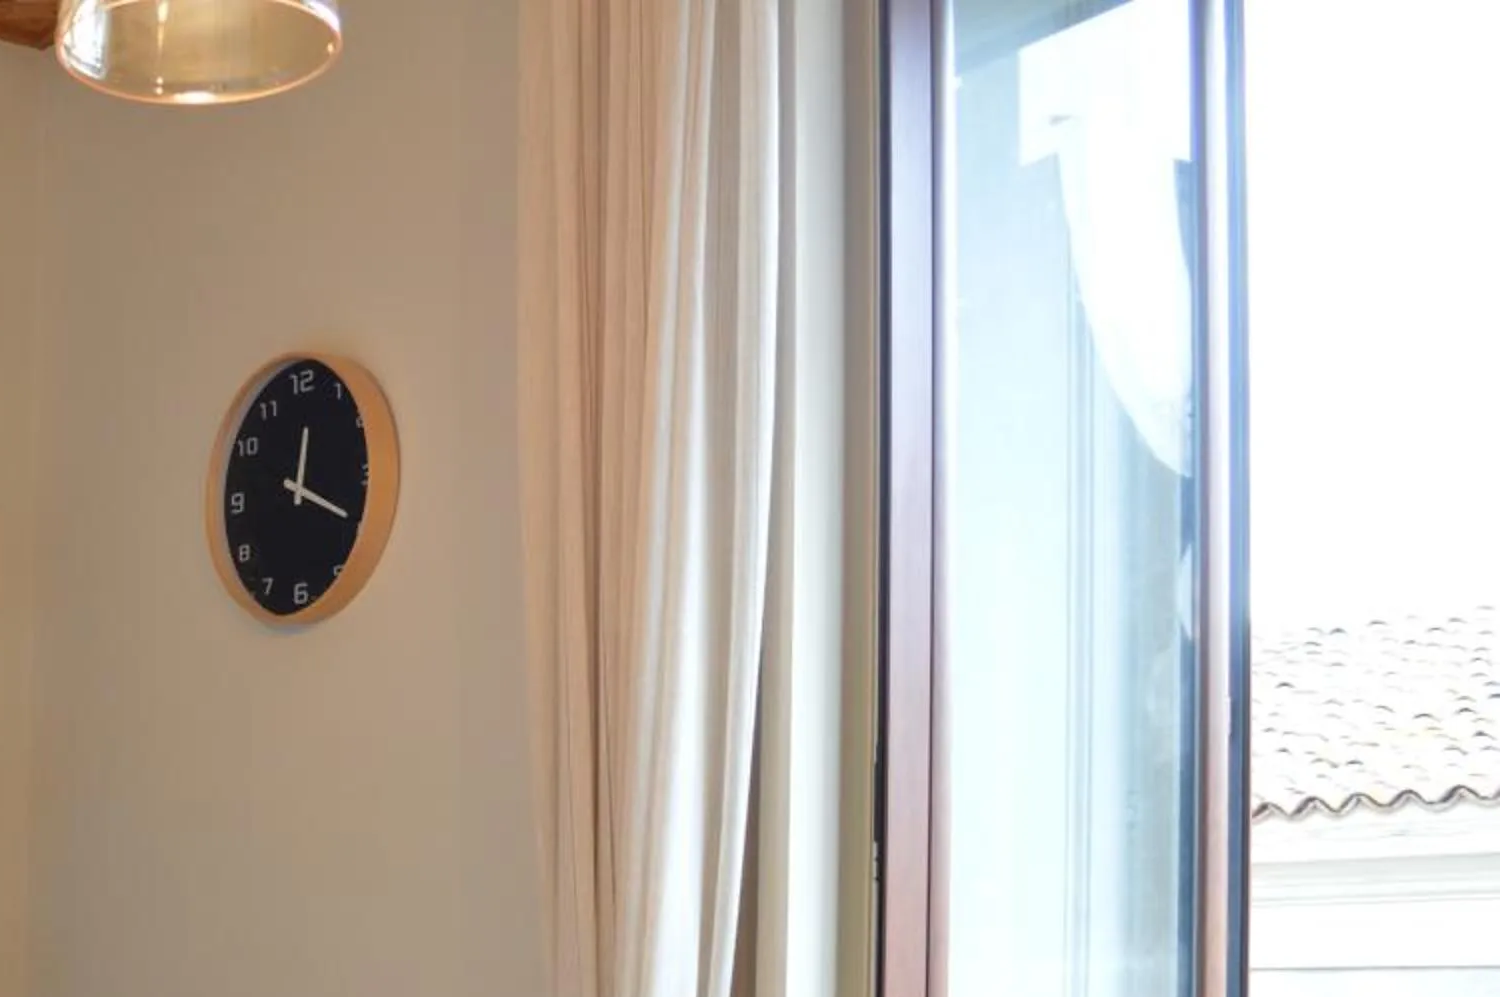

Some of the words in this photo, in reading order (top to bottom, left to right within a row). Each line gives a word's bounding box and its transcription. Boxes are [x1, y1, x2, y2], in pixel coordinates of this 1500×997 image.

[289, 369, 315, 395] 12
[260, 401, 278, 421] 11
[238, 437, 259, 456] 10
[231, 493, 245, 515] 9
[239, 545, 250, 562] 8
[262, 578, 274, 596] 7
[293, 583, 308, 604] 6
